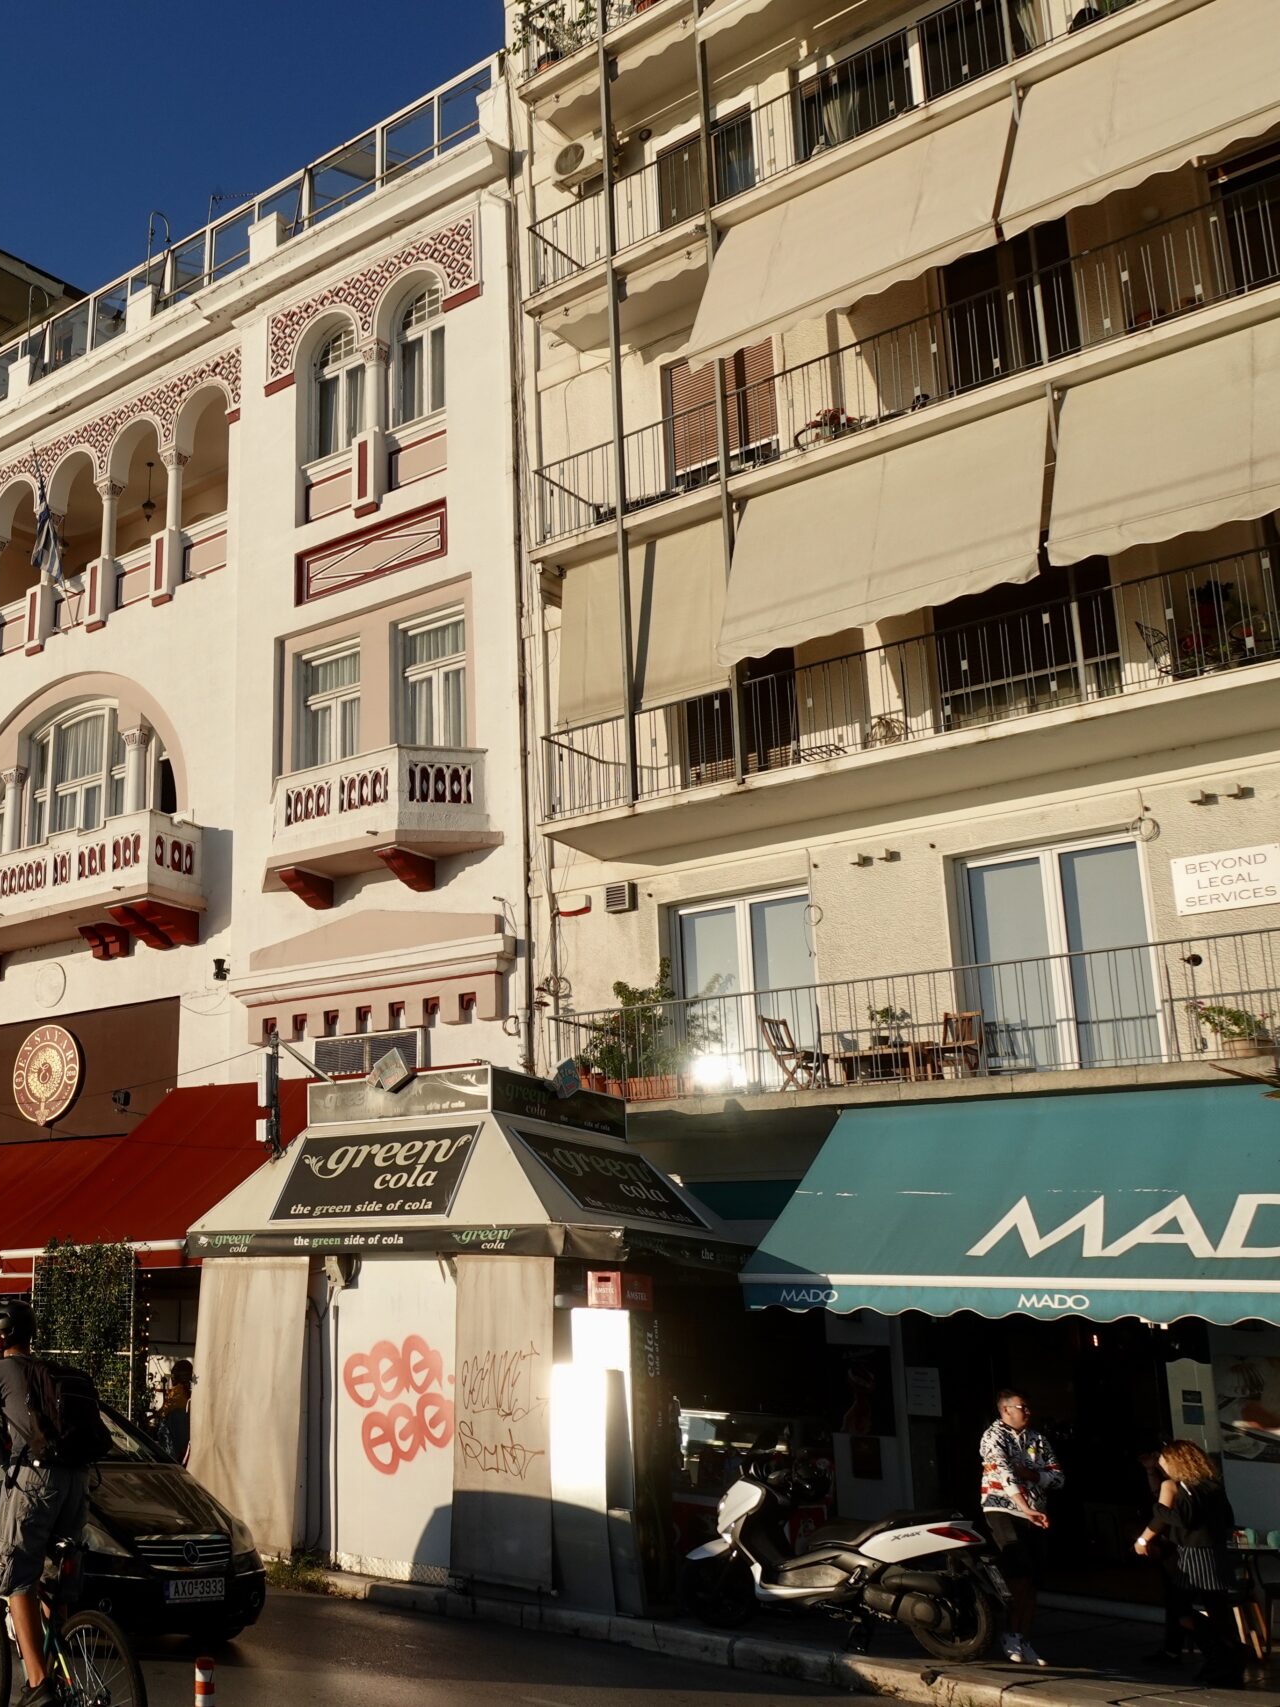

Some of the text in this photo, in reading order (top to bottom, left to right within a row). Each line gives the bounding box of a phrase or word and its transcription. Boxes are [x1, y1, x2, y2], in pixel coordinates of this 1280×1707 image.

[1185, 853, 1267, 875] BEYOND
[1197, 872, 1260, 889] LEGAL
[1185, 886, 1278, 907] SERVICES
[310, 1134, 471, 1178] green
[548, 1147, 653, 1184] green
[374, 1163, 438, 1190] cola
[620, 1181, 670, 1203] cola
[290, 1199, 432, 1217] the green side of cola
[211, 1233, 255, 1248] green
[293, 1234, 404, 1248] the green side of cola
[455, 1228, 516, 1245] green
[481, 1239, 506, 1250] cola
[229, 1244, 248, 1253] cola
[701, 1247, 715, 1260] the
[626, 1290, 649, 1301] AMSTEL
[780, 1289, 838, 1303] MADO
[1018, 1294, 1089, 1311] MADO
[645, 1332, 655, 1378] cola
